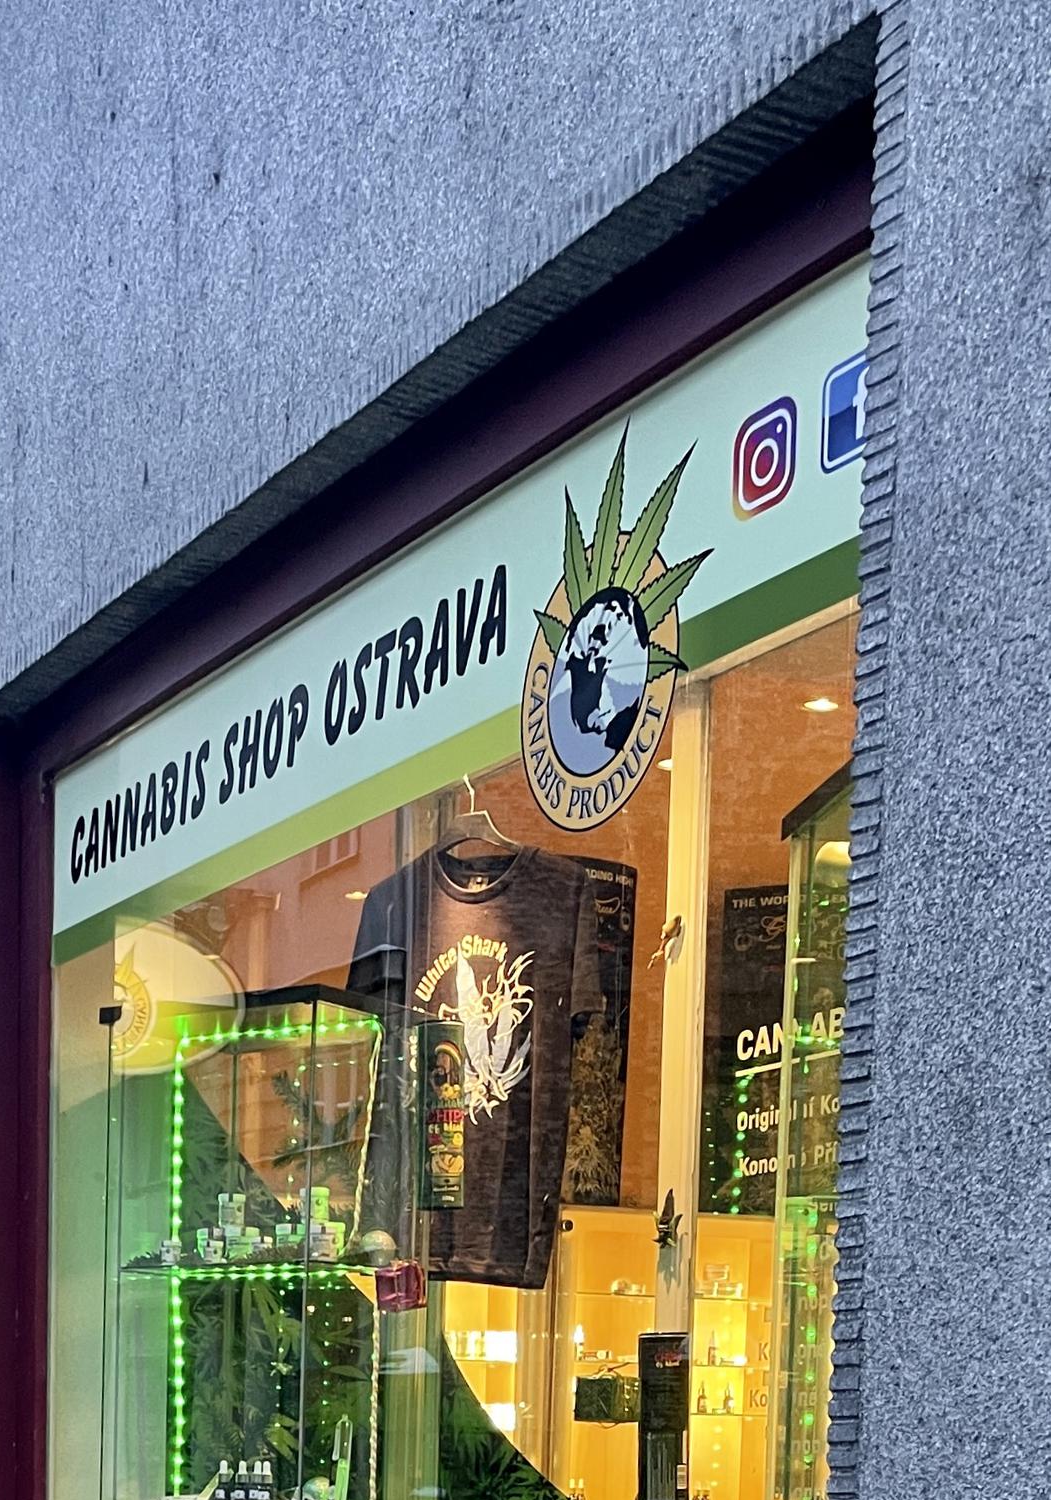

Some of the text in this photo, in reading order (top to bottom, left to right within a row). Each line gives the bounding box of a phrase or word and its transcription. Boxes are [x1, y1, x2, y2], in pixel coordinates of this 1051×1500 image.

[70, 564, 507, 885] CANNABIS SHOP OSTRAVA
[528, 662, 663, 820] CANABIS PRODUCT
[732, 897, 756, 909] THE
[414, 934, 508, 1002] White Shark
[736, 1006, 846, 1062] CANNAB
